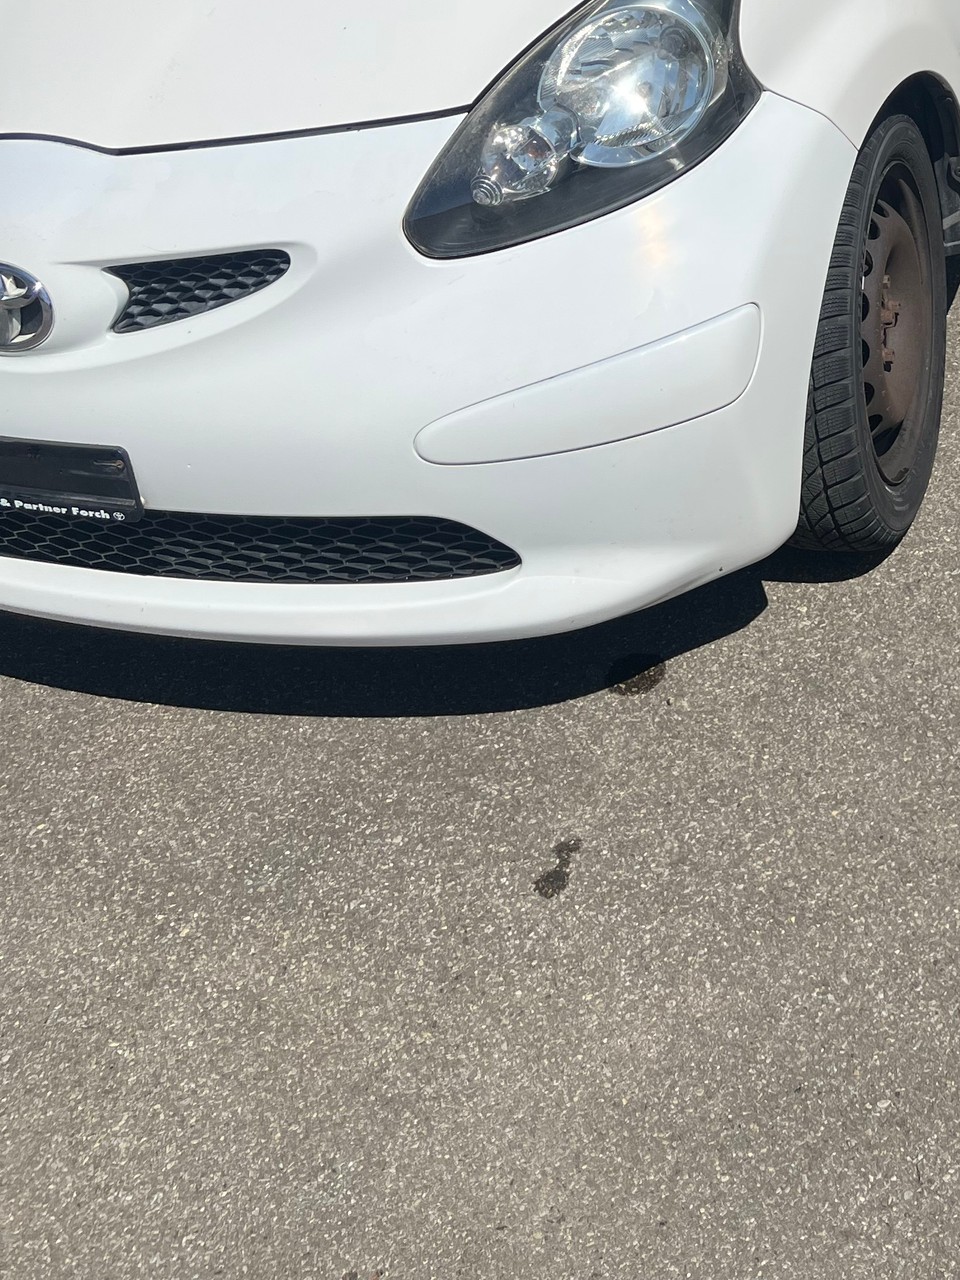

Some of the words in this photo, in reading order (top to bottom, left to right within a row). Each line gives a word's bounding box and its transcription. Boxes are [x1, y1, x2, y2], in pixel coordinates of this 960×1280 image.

[0, 498, 11, 507] &
[14, 500, 67, 514] Partner
[71, 507, 110, 519] Forch
